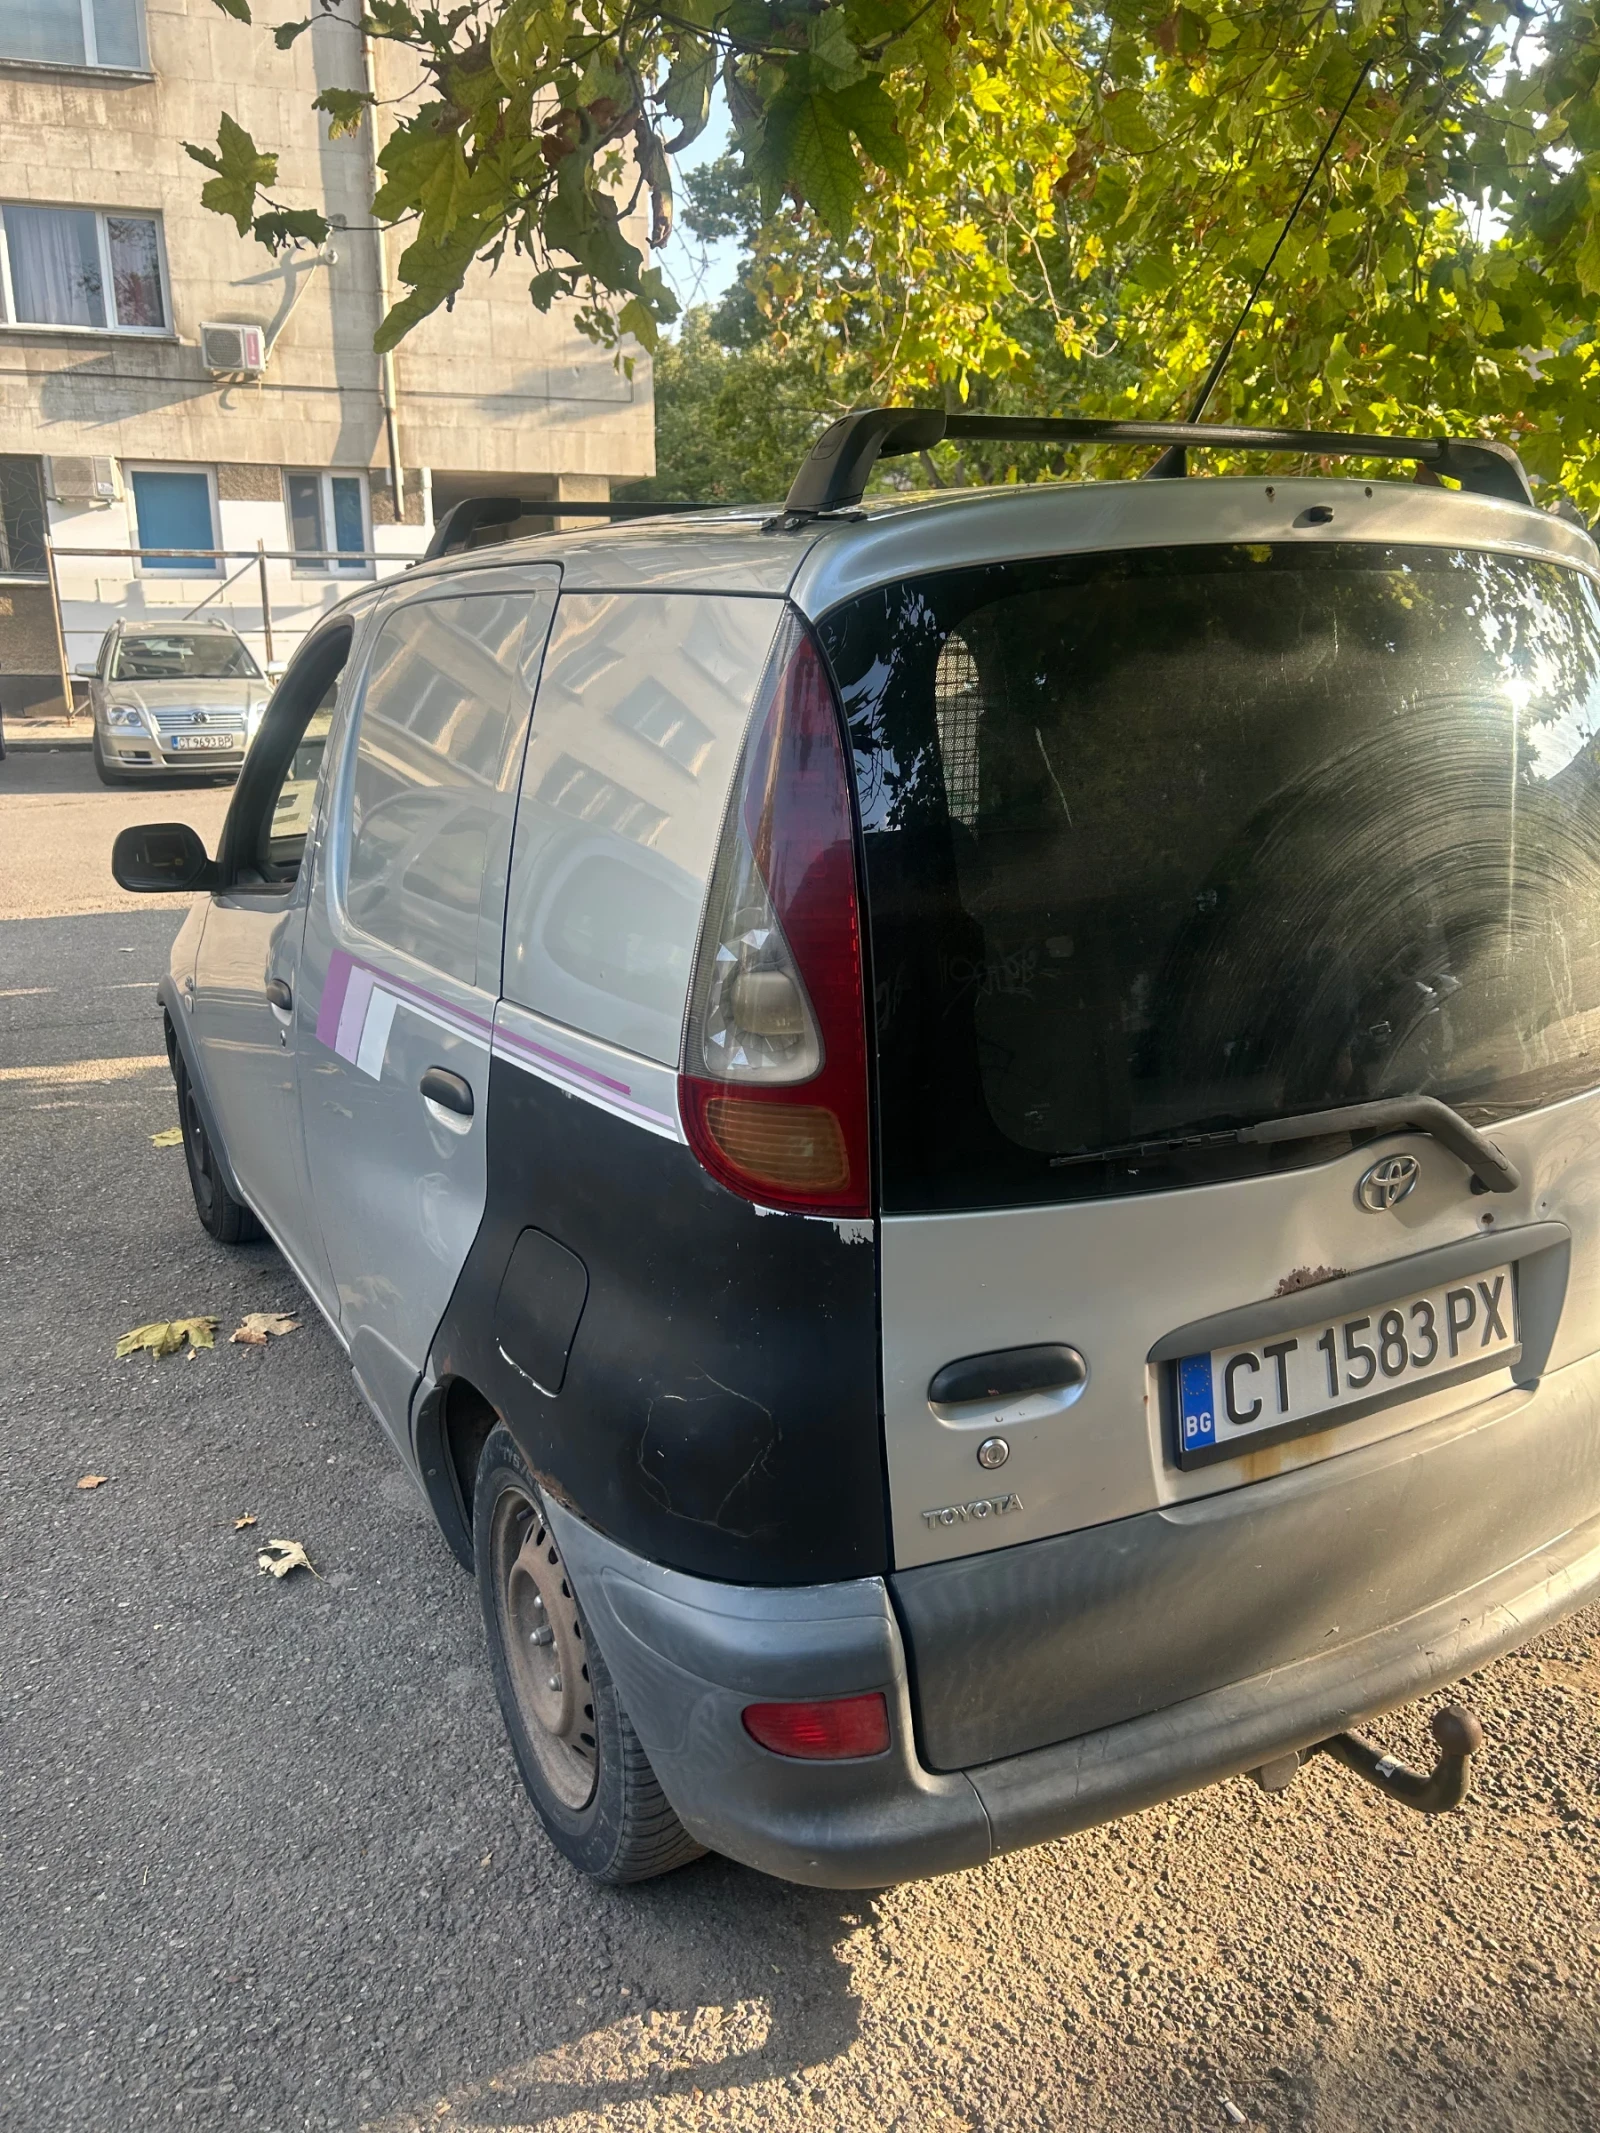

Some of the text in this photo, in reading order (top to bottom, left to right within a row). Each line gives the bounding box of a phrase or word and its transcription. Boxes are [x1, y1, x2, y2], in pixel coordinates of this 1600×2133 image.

[179, 737, 191, 748] CT
[218, 736, 231, 747] BP
[1223, 1274, 1508, 1425] CT 1583 PX
[1185, 1411, 1212, 1438] BG
[922, 1493, 1024, 1530] TOYOTA
